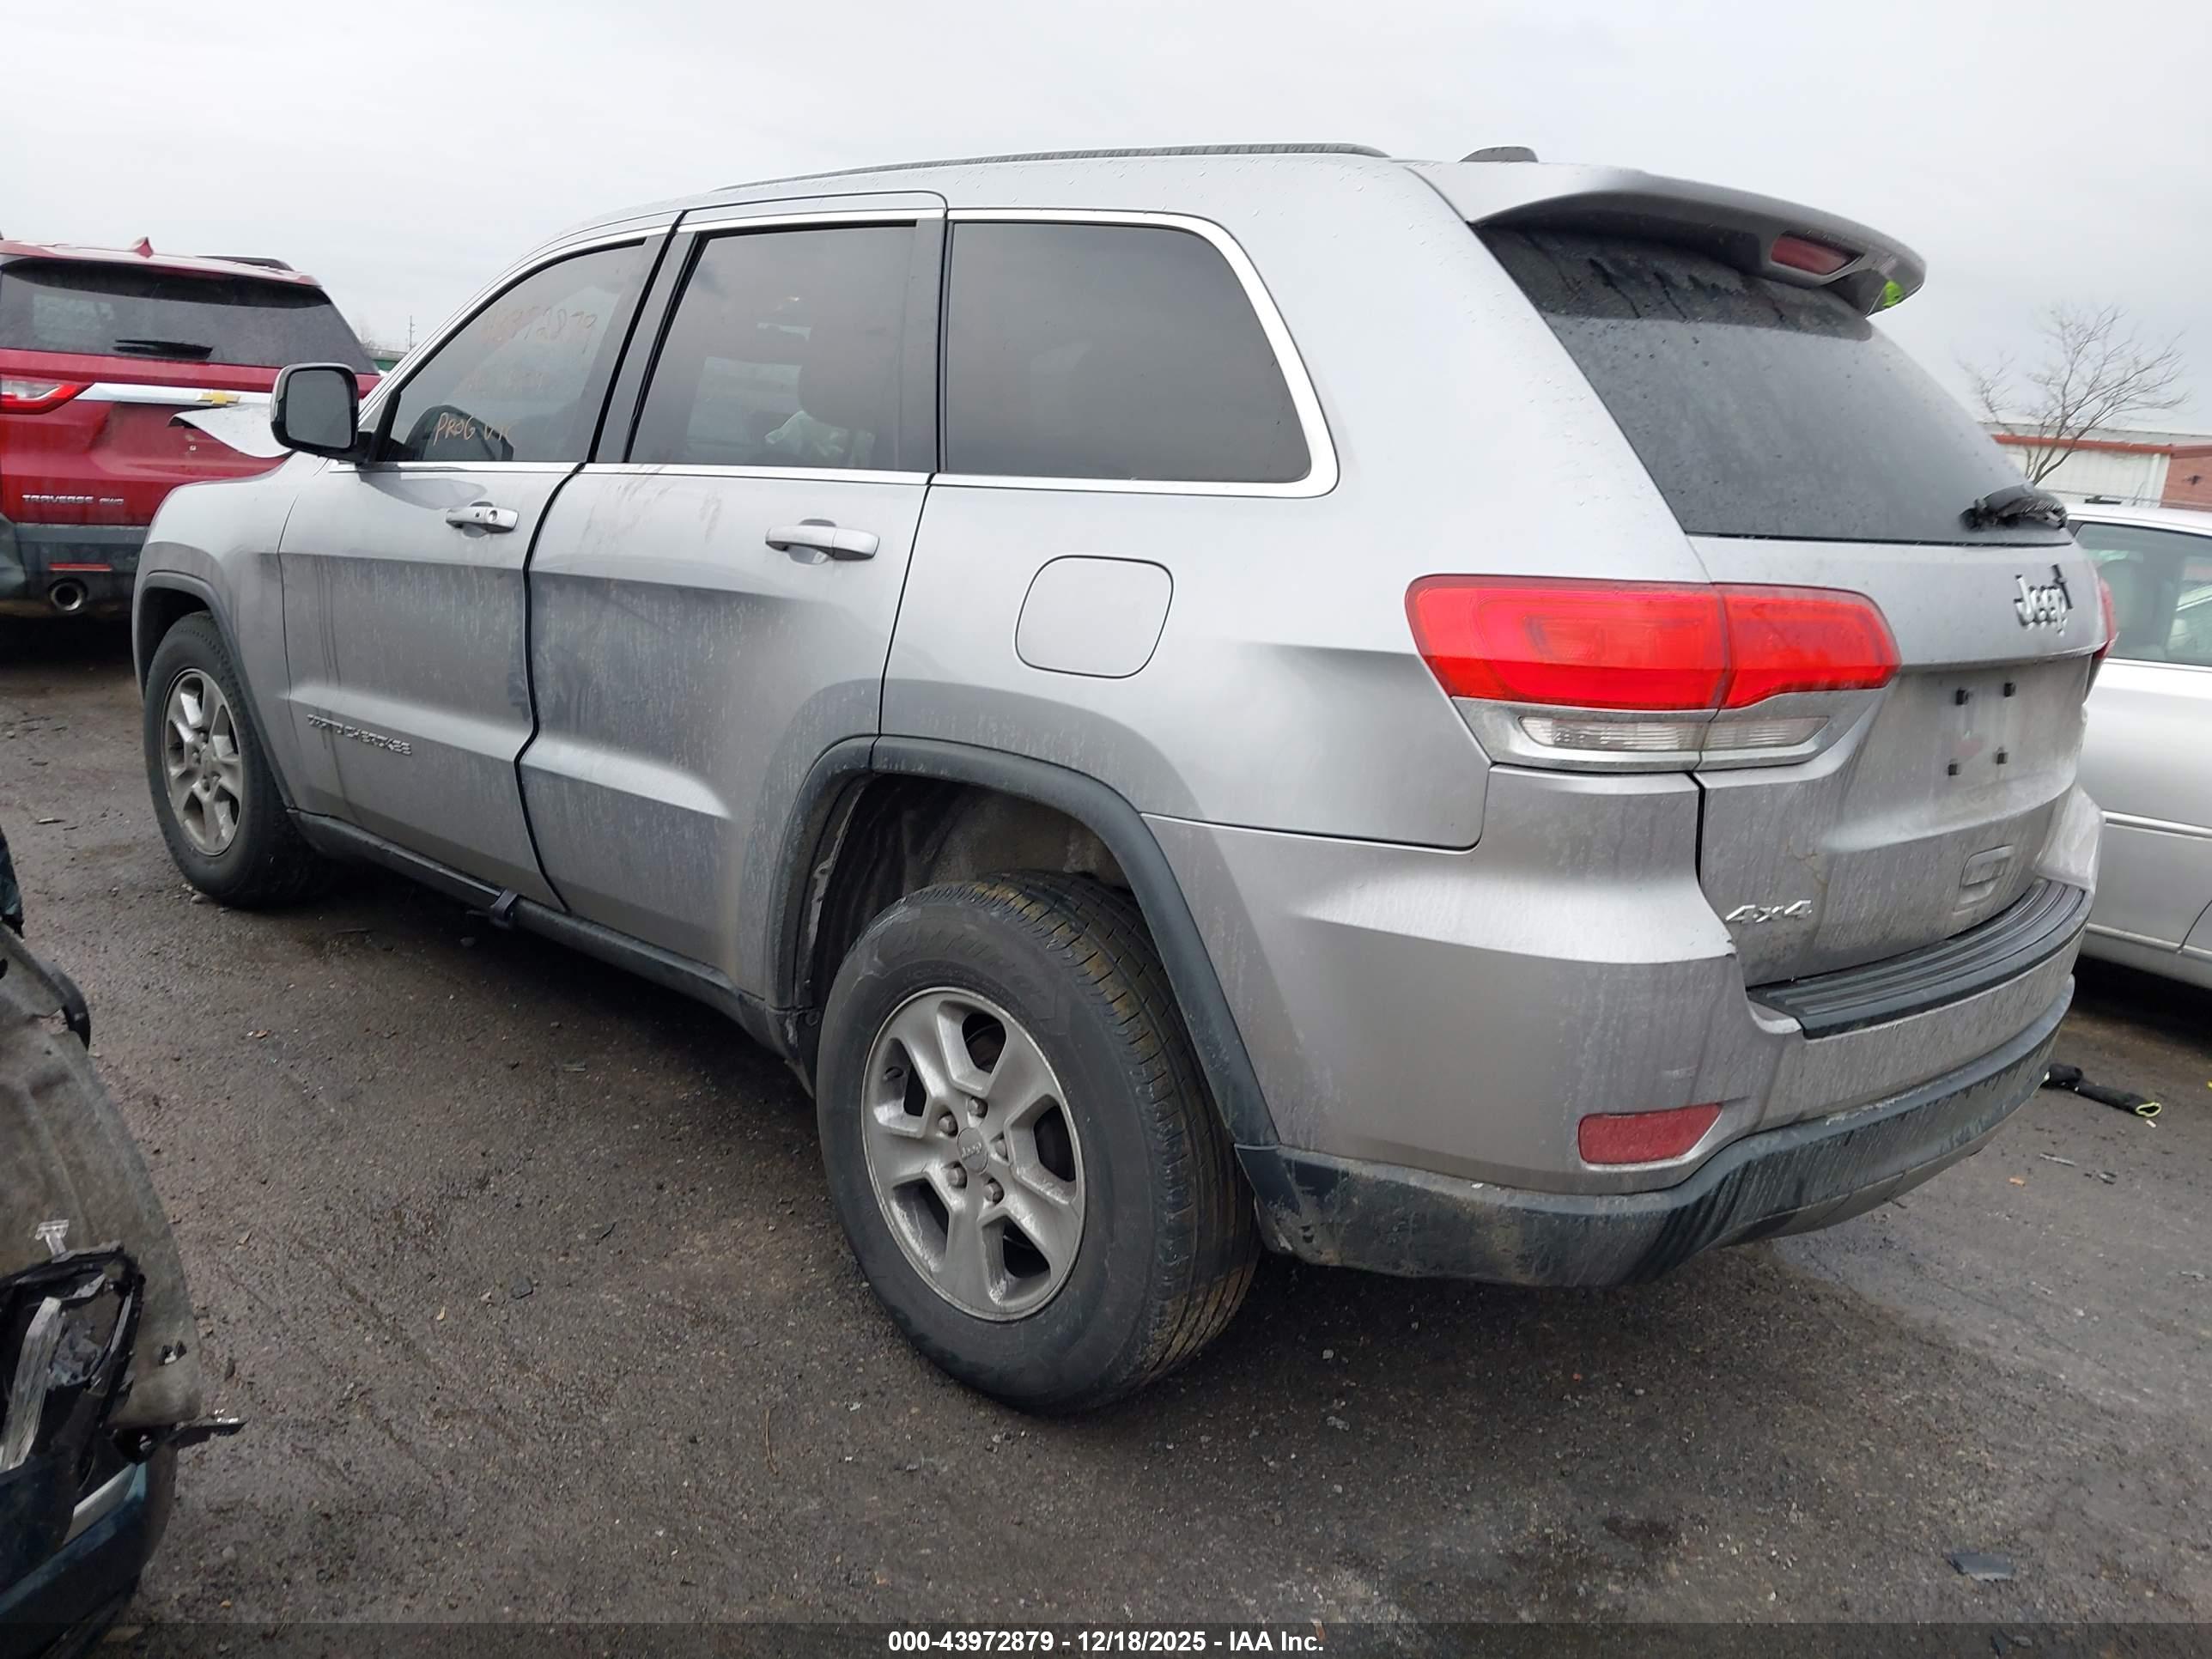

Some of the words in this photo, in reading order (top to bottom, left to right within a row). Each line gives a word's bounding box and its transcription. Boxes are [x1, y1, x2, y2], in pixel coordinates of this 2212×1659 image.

[22, 493, 94, 504] TRAVERSE
[2014, 566, 2072, 637] Jeep
[1725, 900, 1813, 924] 4x4
